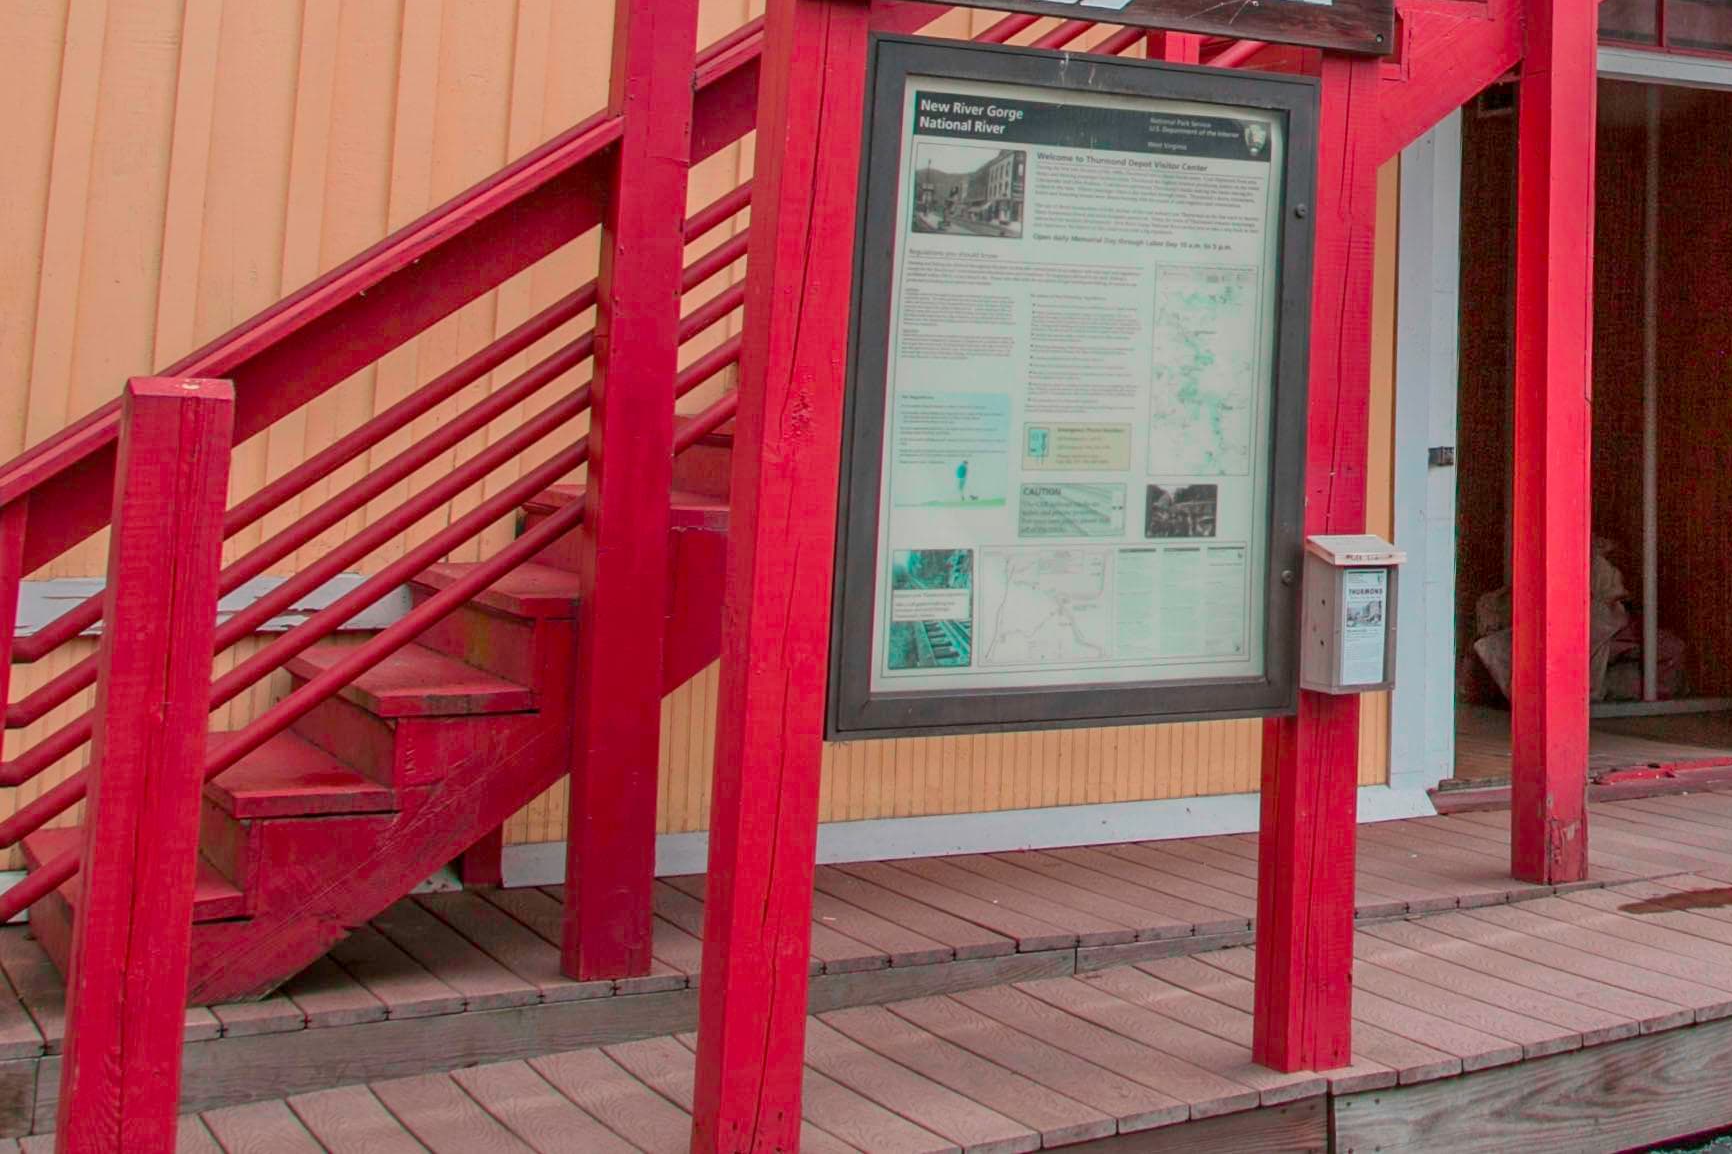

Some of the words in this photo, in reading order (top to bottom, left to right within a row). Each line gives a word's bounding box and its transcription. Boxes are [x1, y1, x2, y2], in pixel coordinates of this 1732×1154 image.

[920, 99, 950, 113] New
[953, 102, 984, 116] River
[987, 105, 1024, 122] Gorge
[920, 116, 972, 132] National
[974, 120, 1006, 135] River
[1037, 152, 1073, 162] Welcome
[1075, 155, 1084, 163] to
[1086, 155, 1127, 166] Thurmond
[1128, 159, 1152, 170] Depot
[1154, 160, 1180, 170] Visitor
[1181, 163, 1208, 172] Center
[1033, 233, 1051, 242] Open
[1071, 234, 1102, 244] Memorial
[1022, 487, 1062, 497] CAUTION
